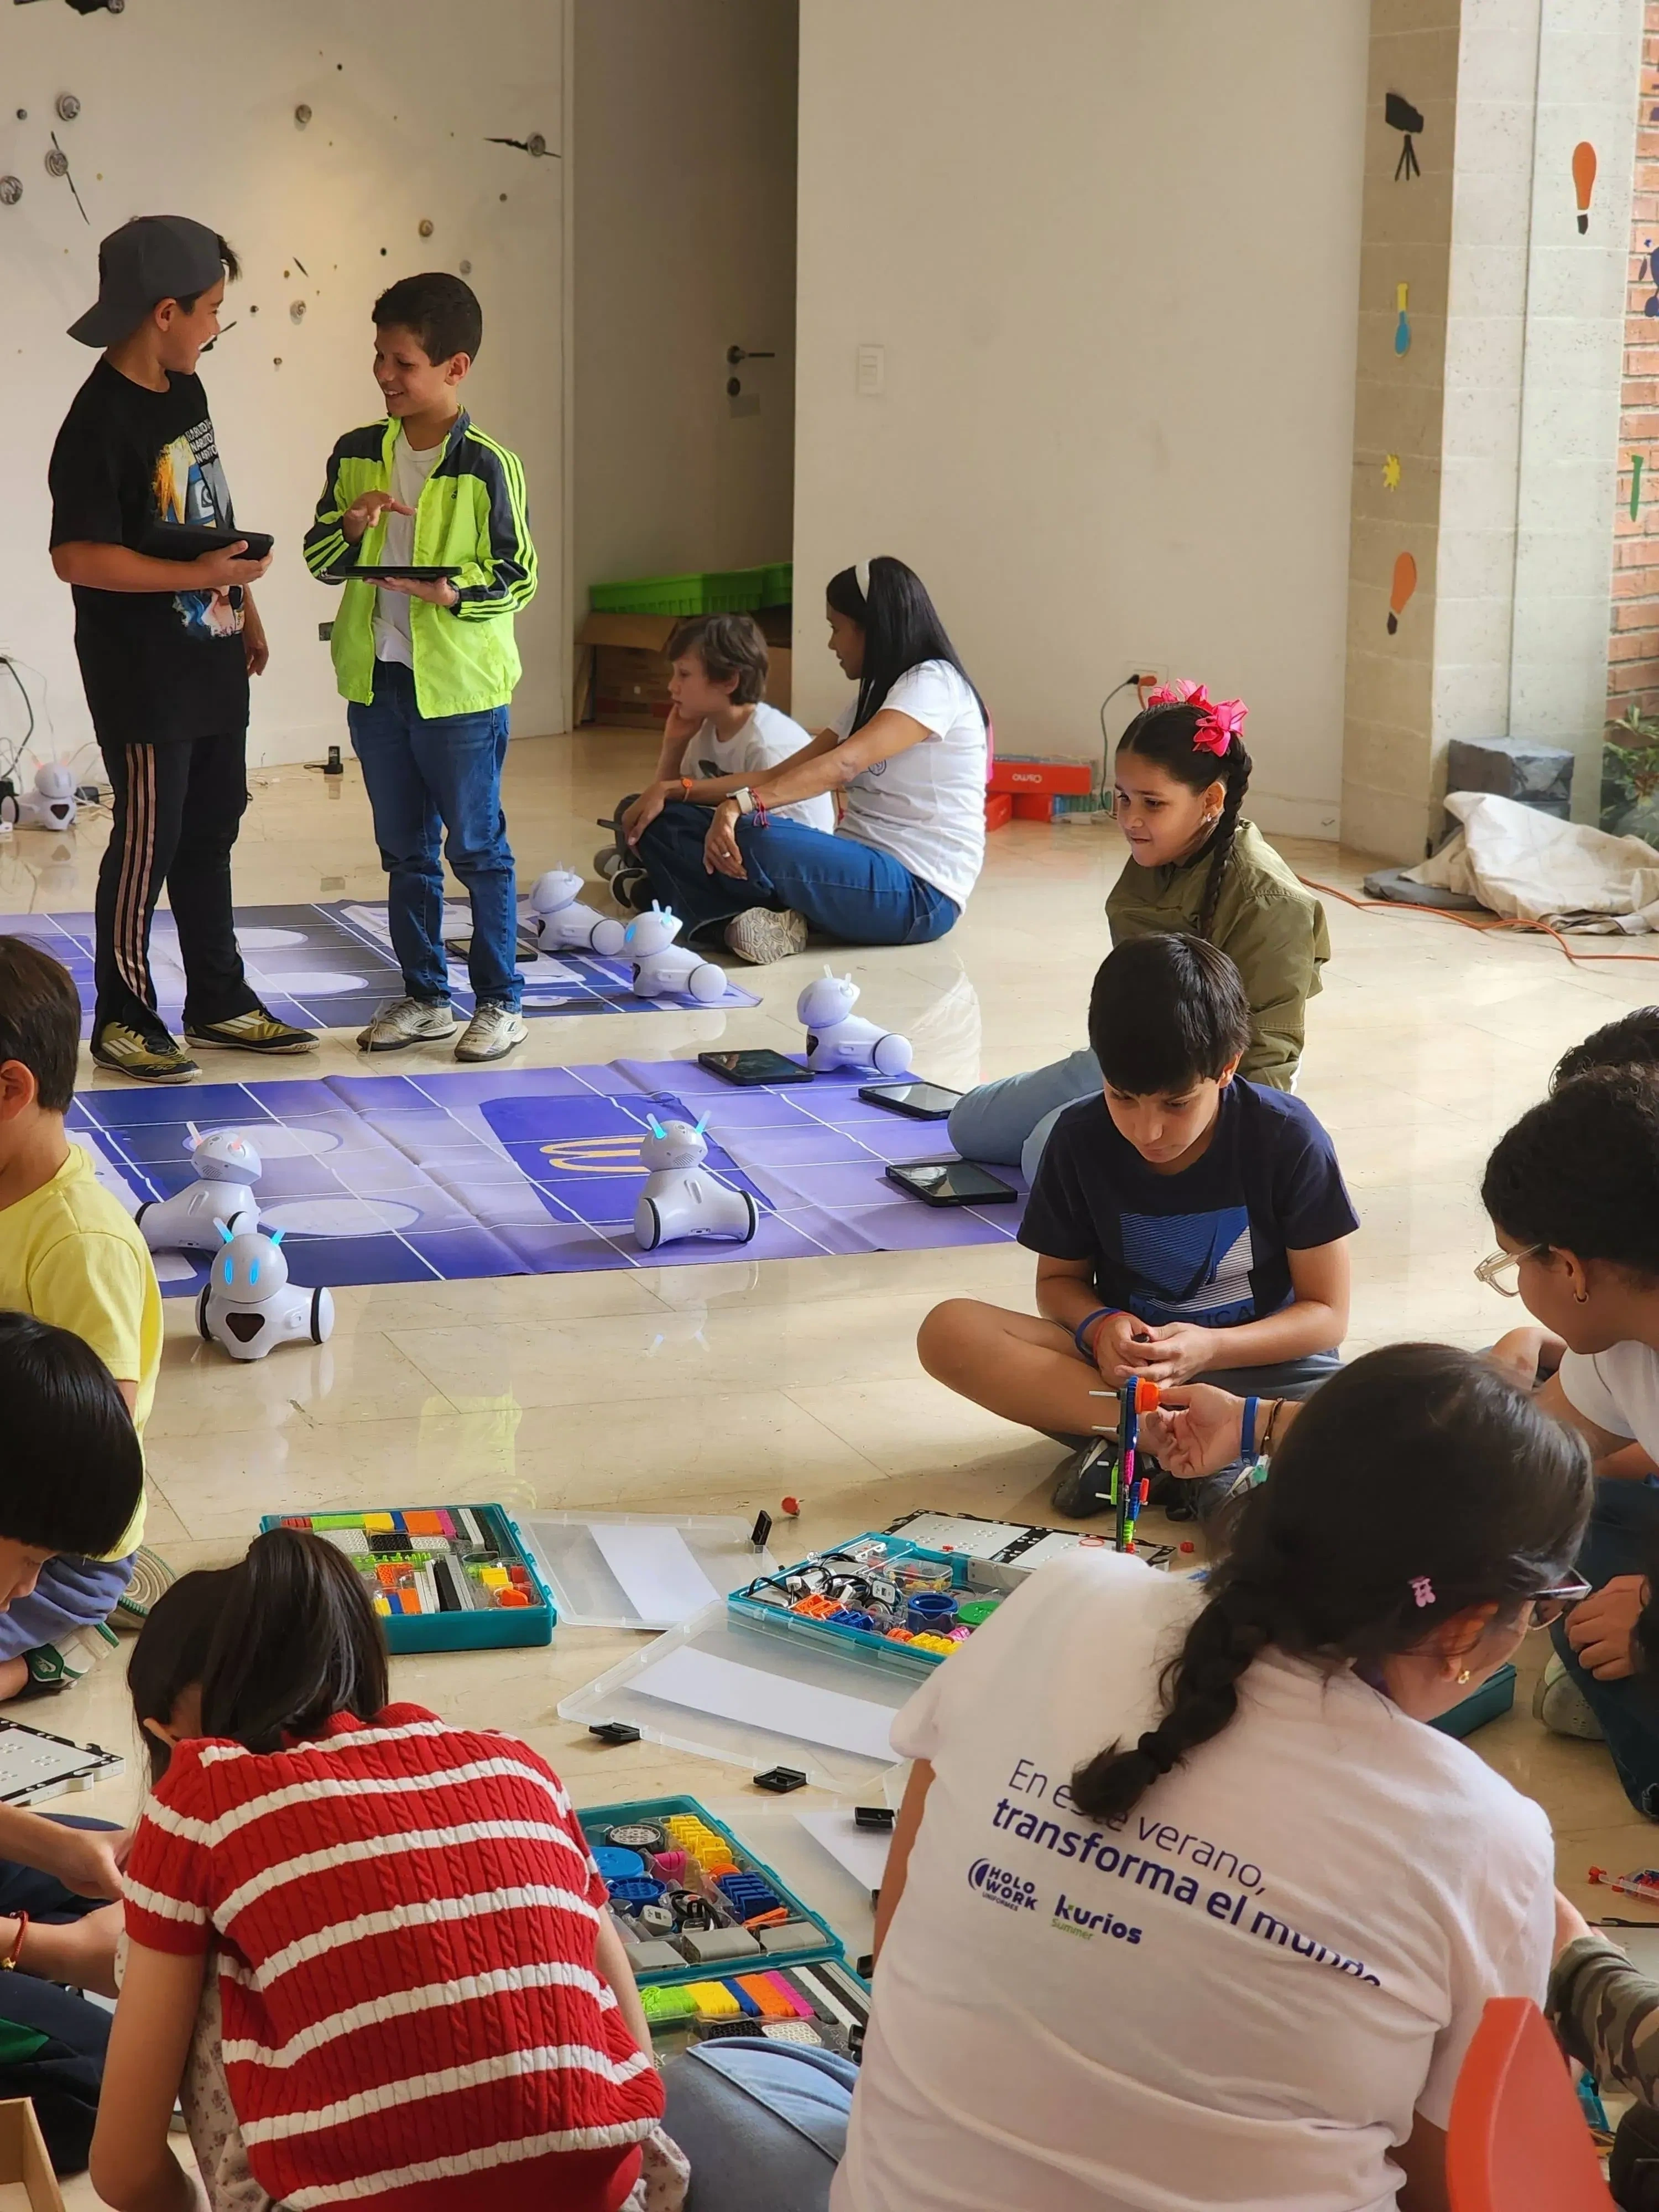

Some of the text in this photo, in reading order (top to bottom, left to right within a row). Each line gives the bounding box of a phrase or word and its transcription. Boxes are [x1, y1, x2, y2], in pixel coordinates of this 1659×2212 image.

[1008, 1759, 1048, 1798] En
[1139, 1817, 1266, 1895] verano,
[989, 1866, 1035, 1894] HOLO
[993, 1798, 1199, 1906] transforma
[1207, 1891, 1248, 1926] el
[986, 1879, 1039, 1911] WORK
[1051, 1917, 1094, 1940] Summer
[1054, 1894, 1142, 1944] kurios
